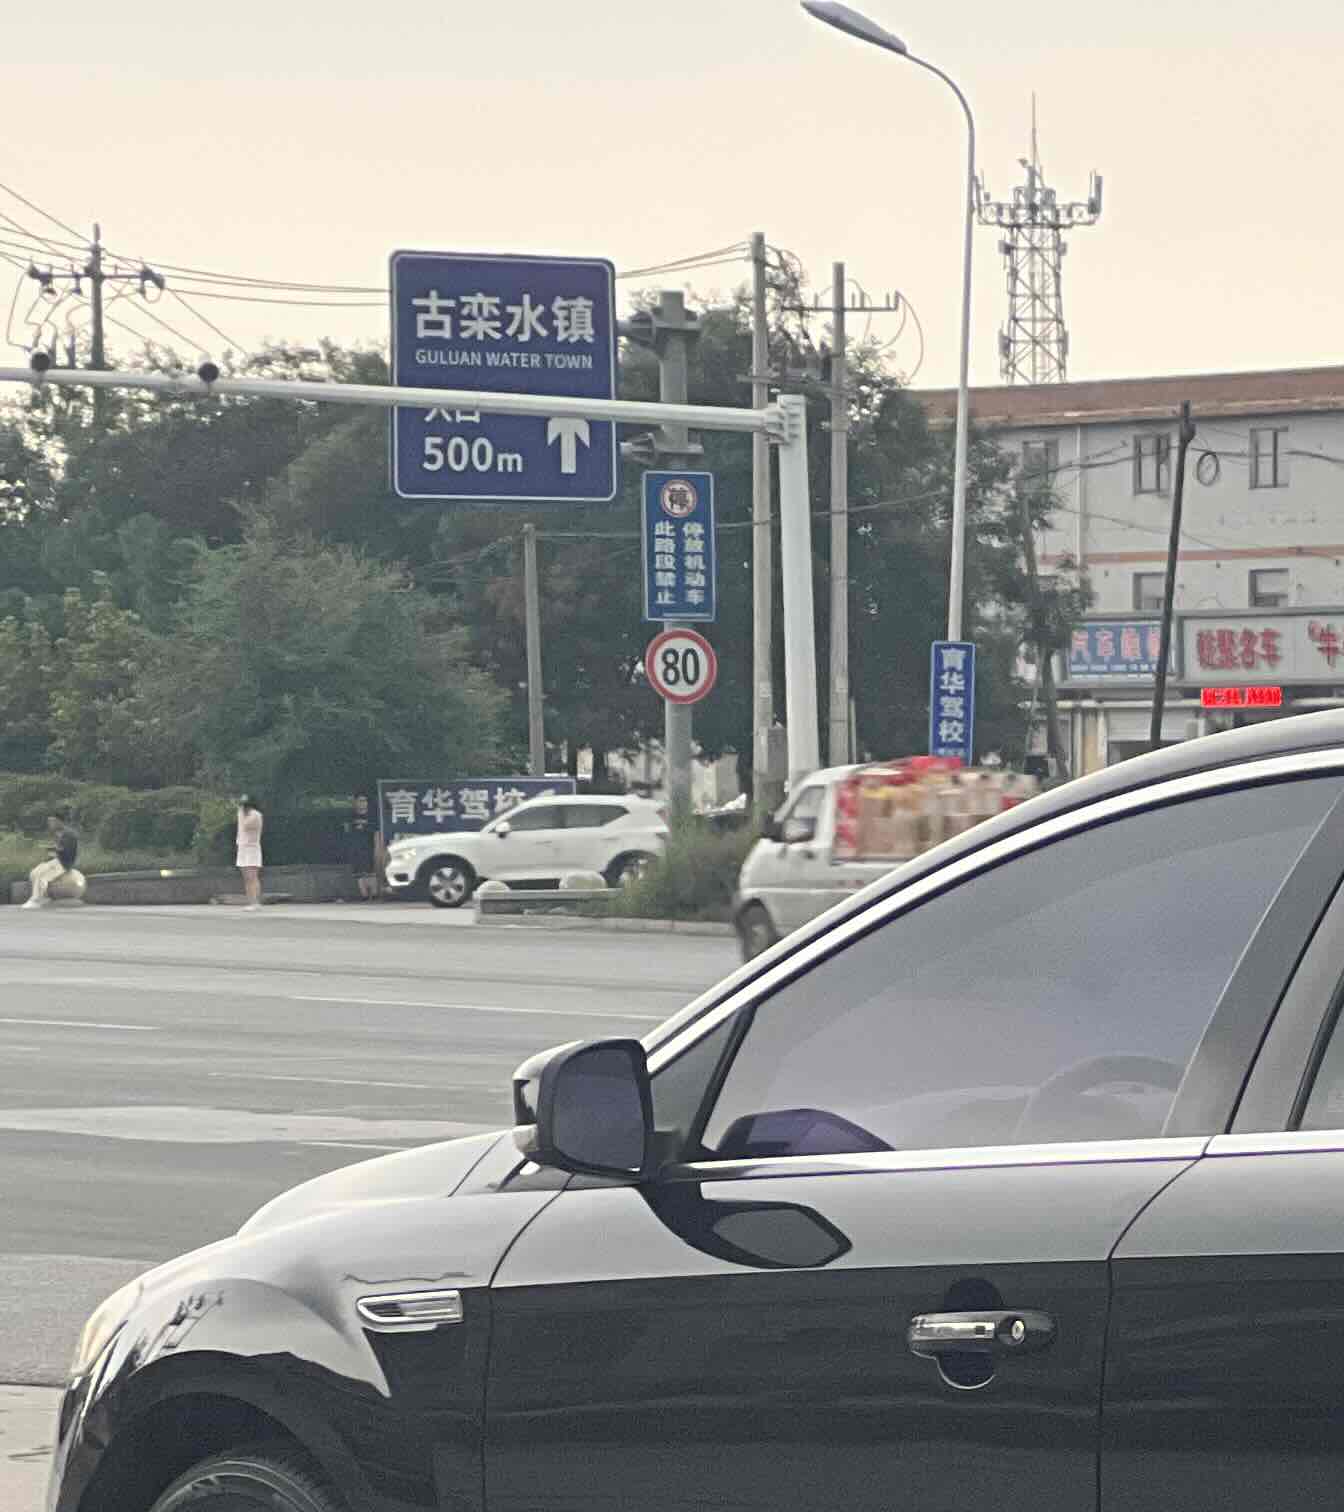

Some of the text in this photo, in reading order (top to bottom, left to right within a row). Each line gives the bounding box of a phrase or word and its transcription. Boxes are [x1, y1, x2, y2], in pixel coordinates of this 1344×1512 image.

[412, 290, 595, 343] 古栾水镇
[415, 349, 593, 369] GULUAN WATER TOWN
[423, 436, 523, 473] 500m
[662, 648, 699, 686] 80
